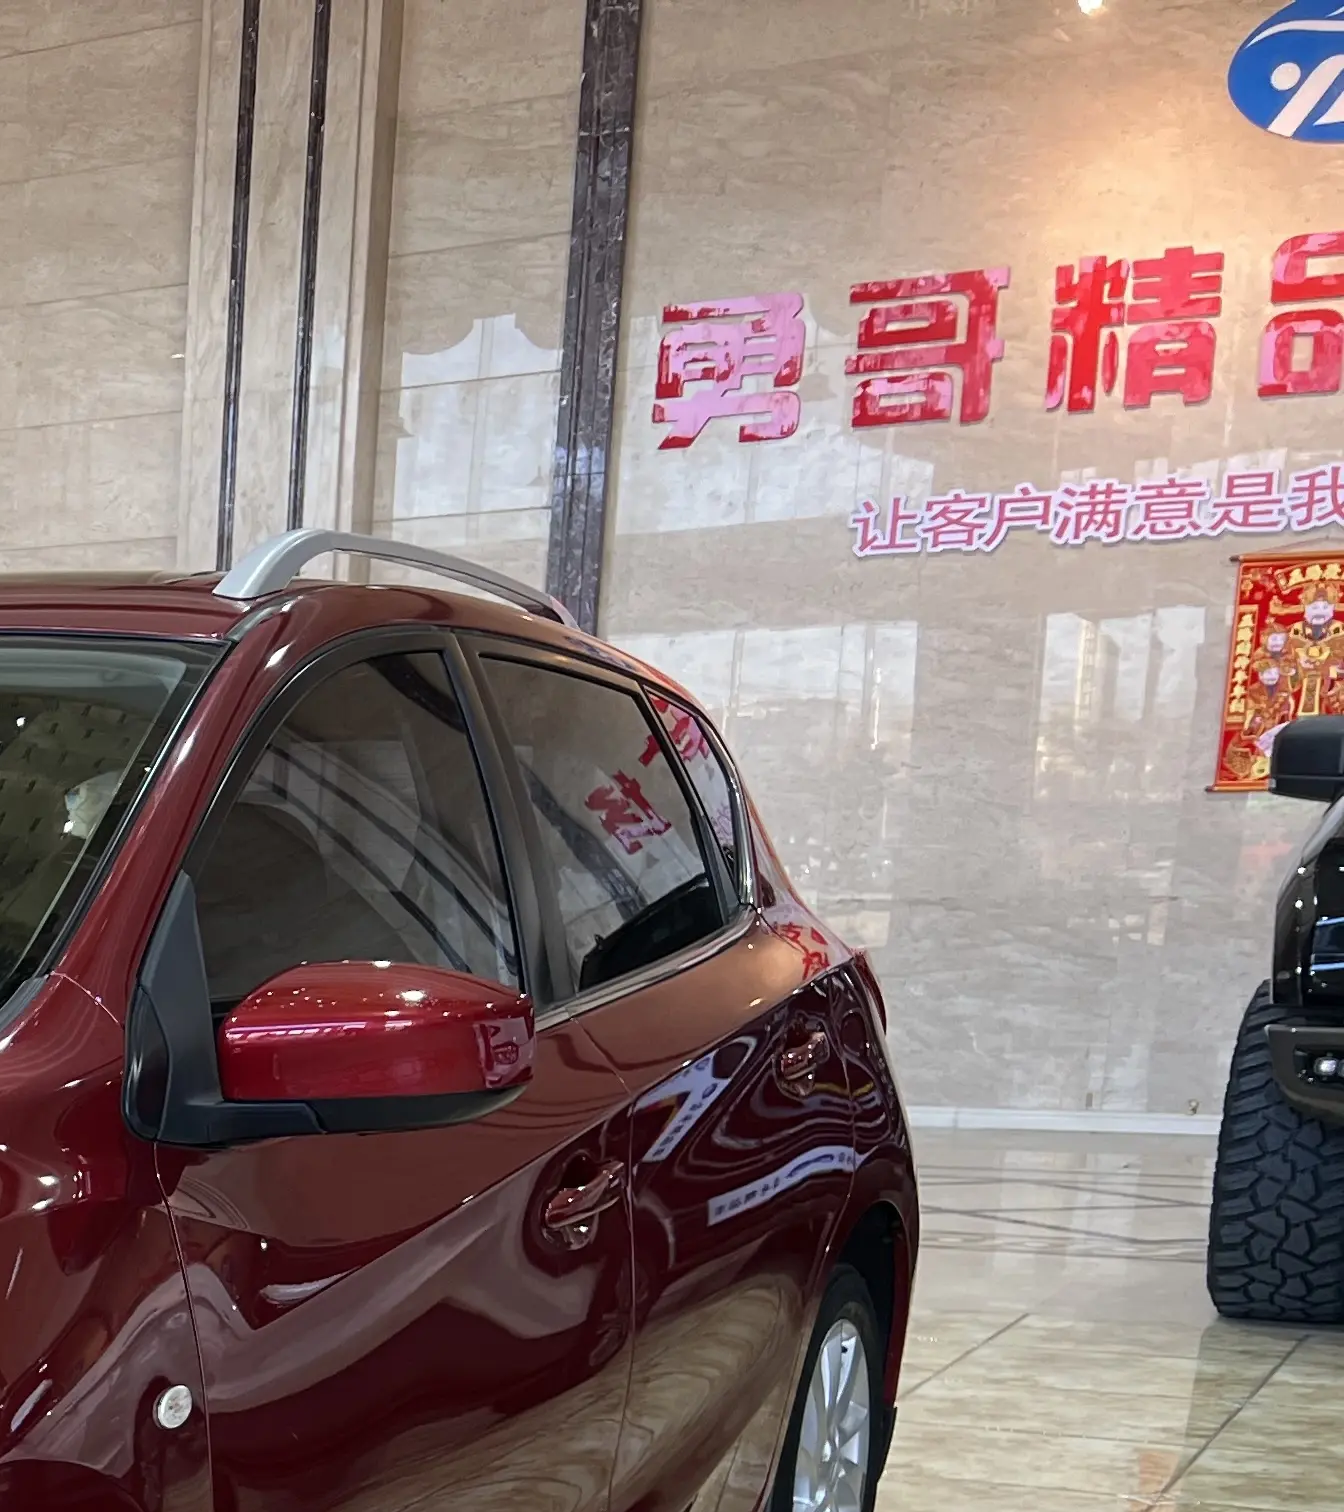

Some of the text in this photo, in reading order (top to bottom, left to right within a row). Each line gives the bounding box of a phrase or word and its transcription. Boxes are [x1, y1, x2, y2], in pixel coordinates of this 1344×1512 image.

[852, 462, 1344, 556] 让客户满意是我
